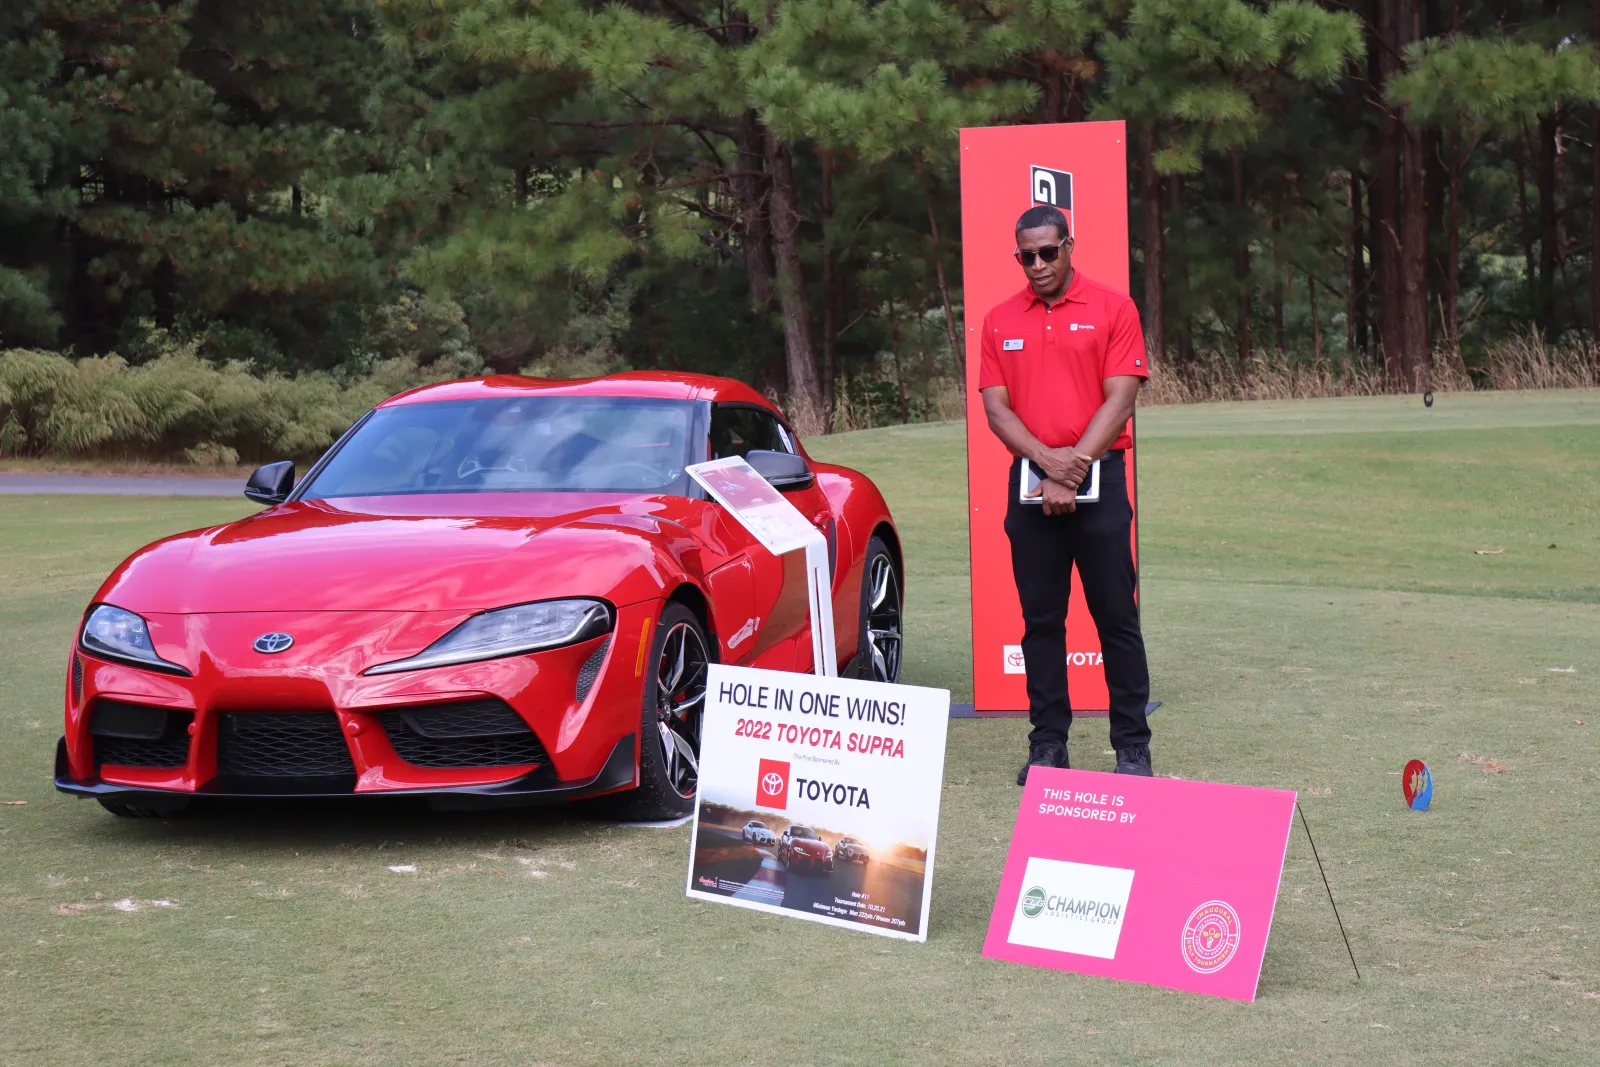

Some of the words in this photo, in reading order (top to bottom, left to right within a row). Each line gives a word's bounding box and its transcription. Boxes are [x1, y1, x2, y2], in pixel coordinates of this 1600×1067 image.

[719, 682, 769, 709] HOLE
[774, 688, 793, 712] IN
[799, 691, 841, 718] ONE
[846, 696, 906, 726] WINS!
[735, 718, 772, 740] 2022
[777, 723, 841, 750] TOYOTA
[846, 732, 904, 759] SUPRA
[812, 756, 834, 765] Sponsored
[796, 778, 870, 809] TOYOTA
[1043, 788, 1071, 801] THIS
[1074, 791, 1108, 806] HOLE
[1111, 795, 1125, 807] IS
[1038, 803, 1116, 822] SPONSORED
[1119, 812, 1136, 824] BY
[834, 897, 857, 907] Tournament
[868, 904, 886, 912] 10.25.21
[1046, 895, 1121, 920] CHAMPION
[1045, 911, 1088, 922] LOGISTICS
[1090, 917, 1117, 925] GROUP
[1196, 907, 1233, 925] INAUGURAL
[1194, 945, 1232, 967] TOURNAMENT
